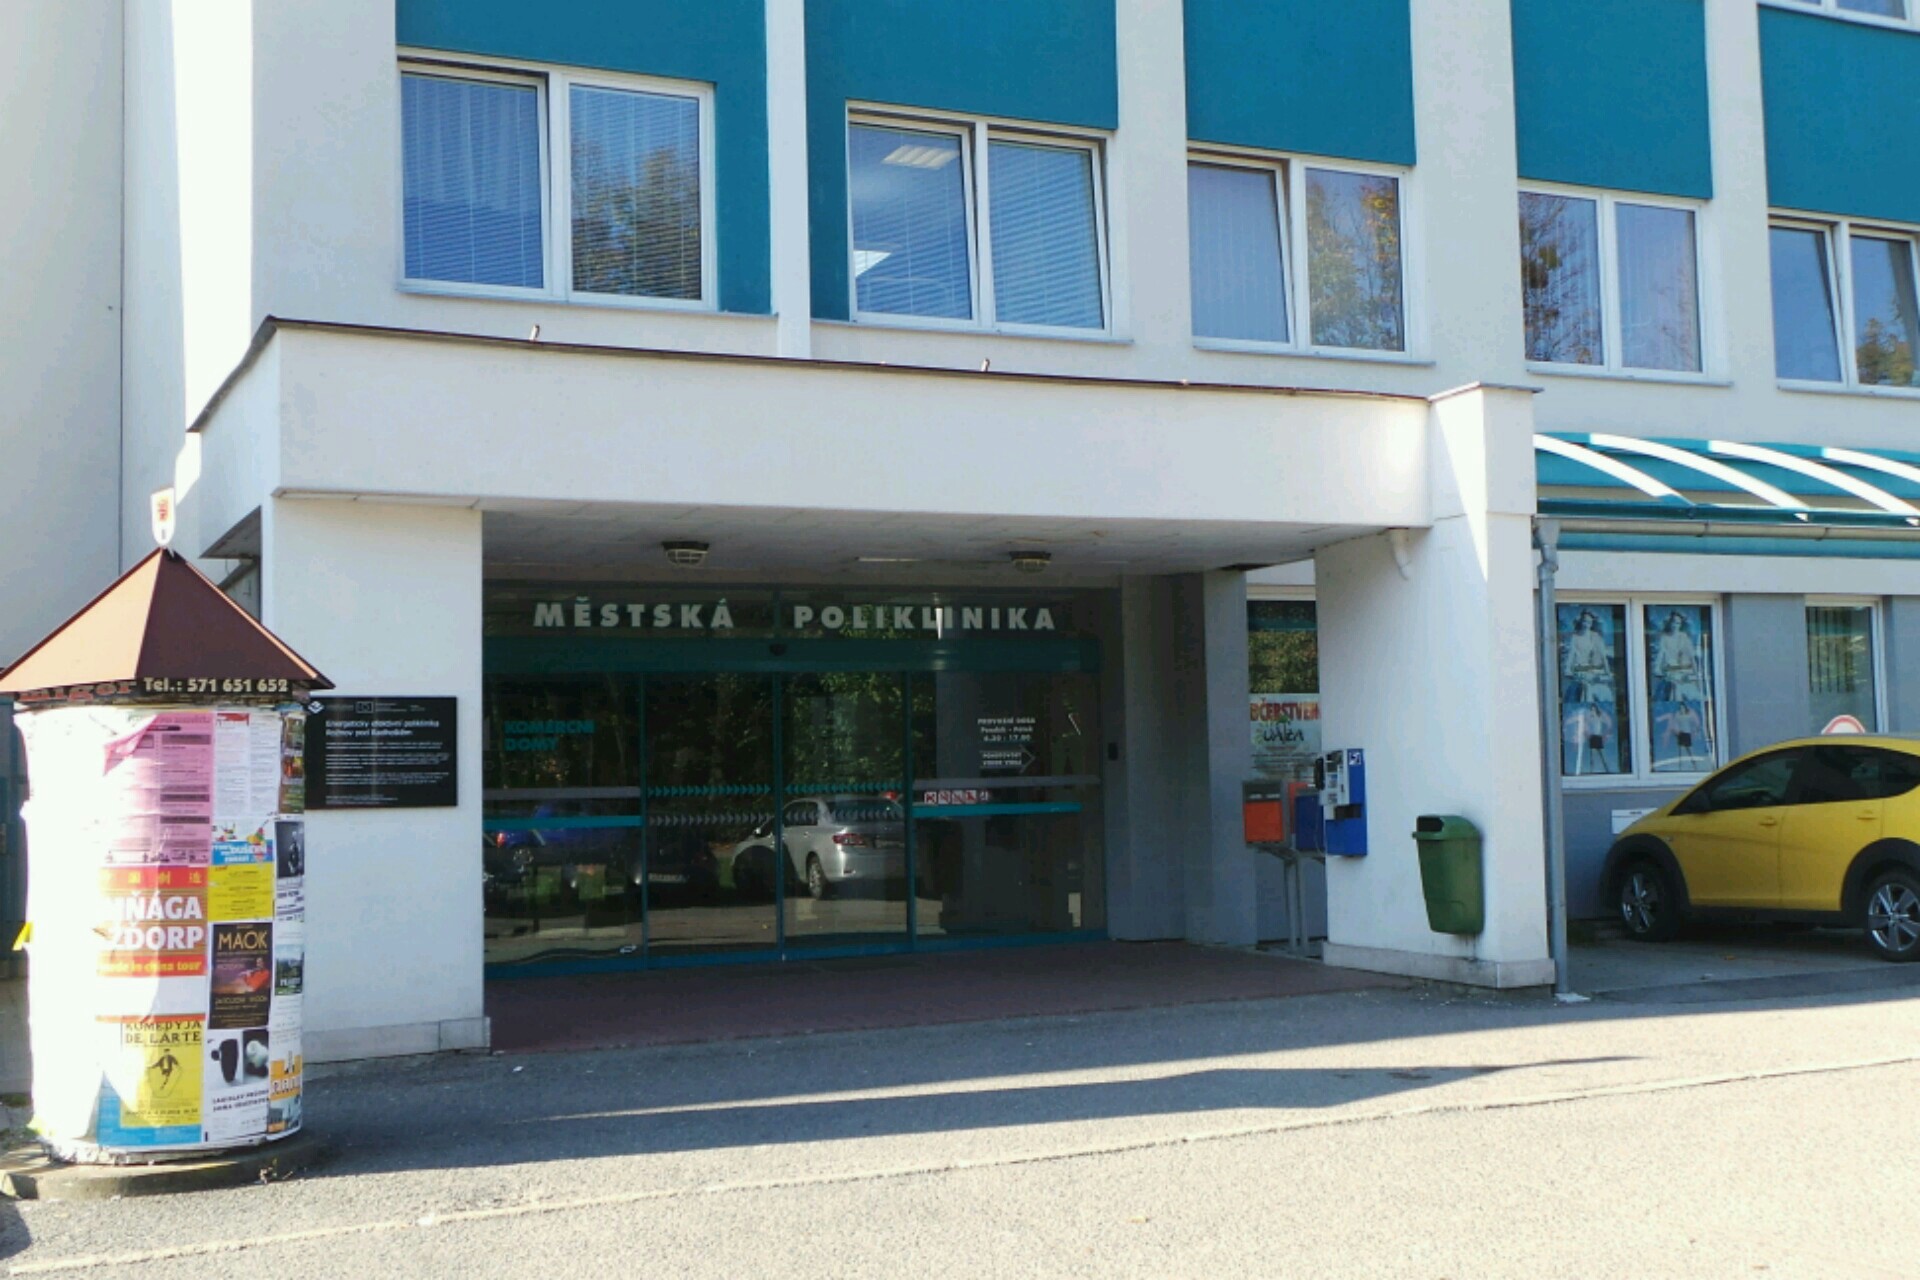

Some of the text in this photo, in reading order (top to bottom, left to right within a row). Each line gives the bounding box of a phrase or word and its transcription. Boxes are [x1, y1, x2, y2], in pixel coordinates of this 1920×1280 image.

[533, 597, 1055, 630] MĚSTSKÁ POLIKLINIKA
[144, 677, 288, 693] Tel.: 571 651 652
[126, 1033, 143, 1044] DE
